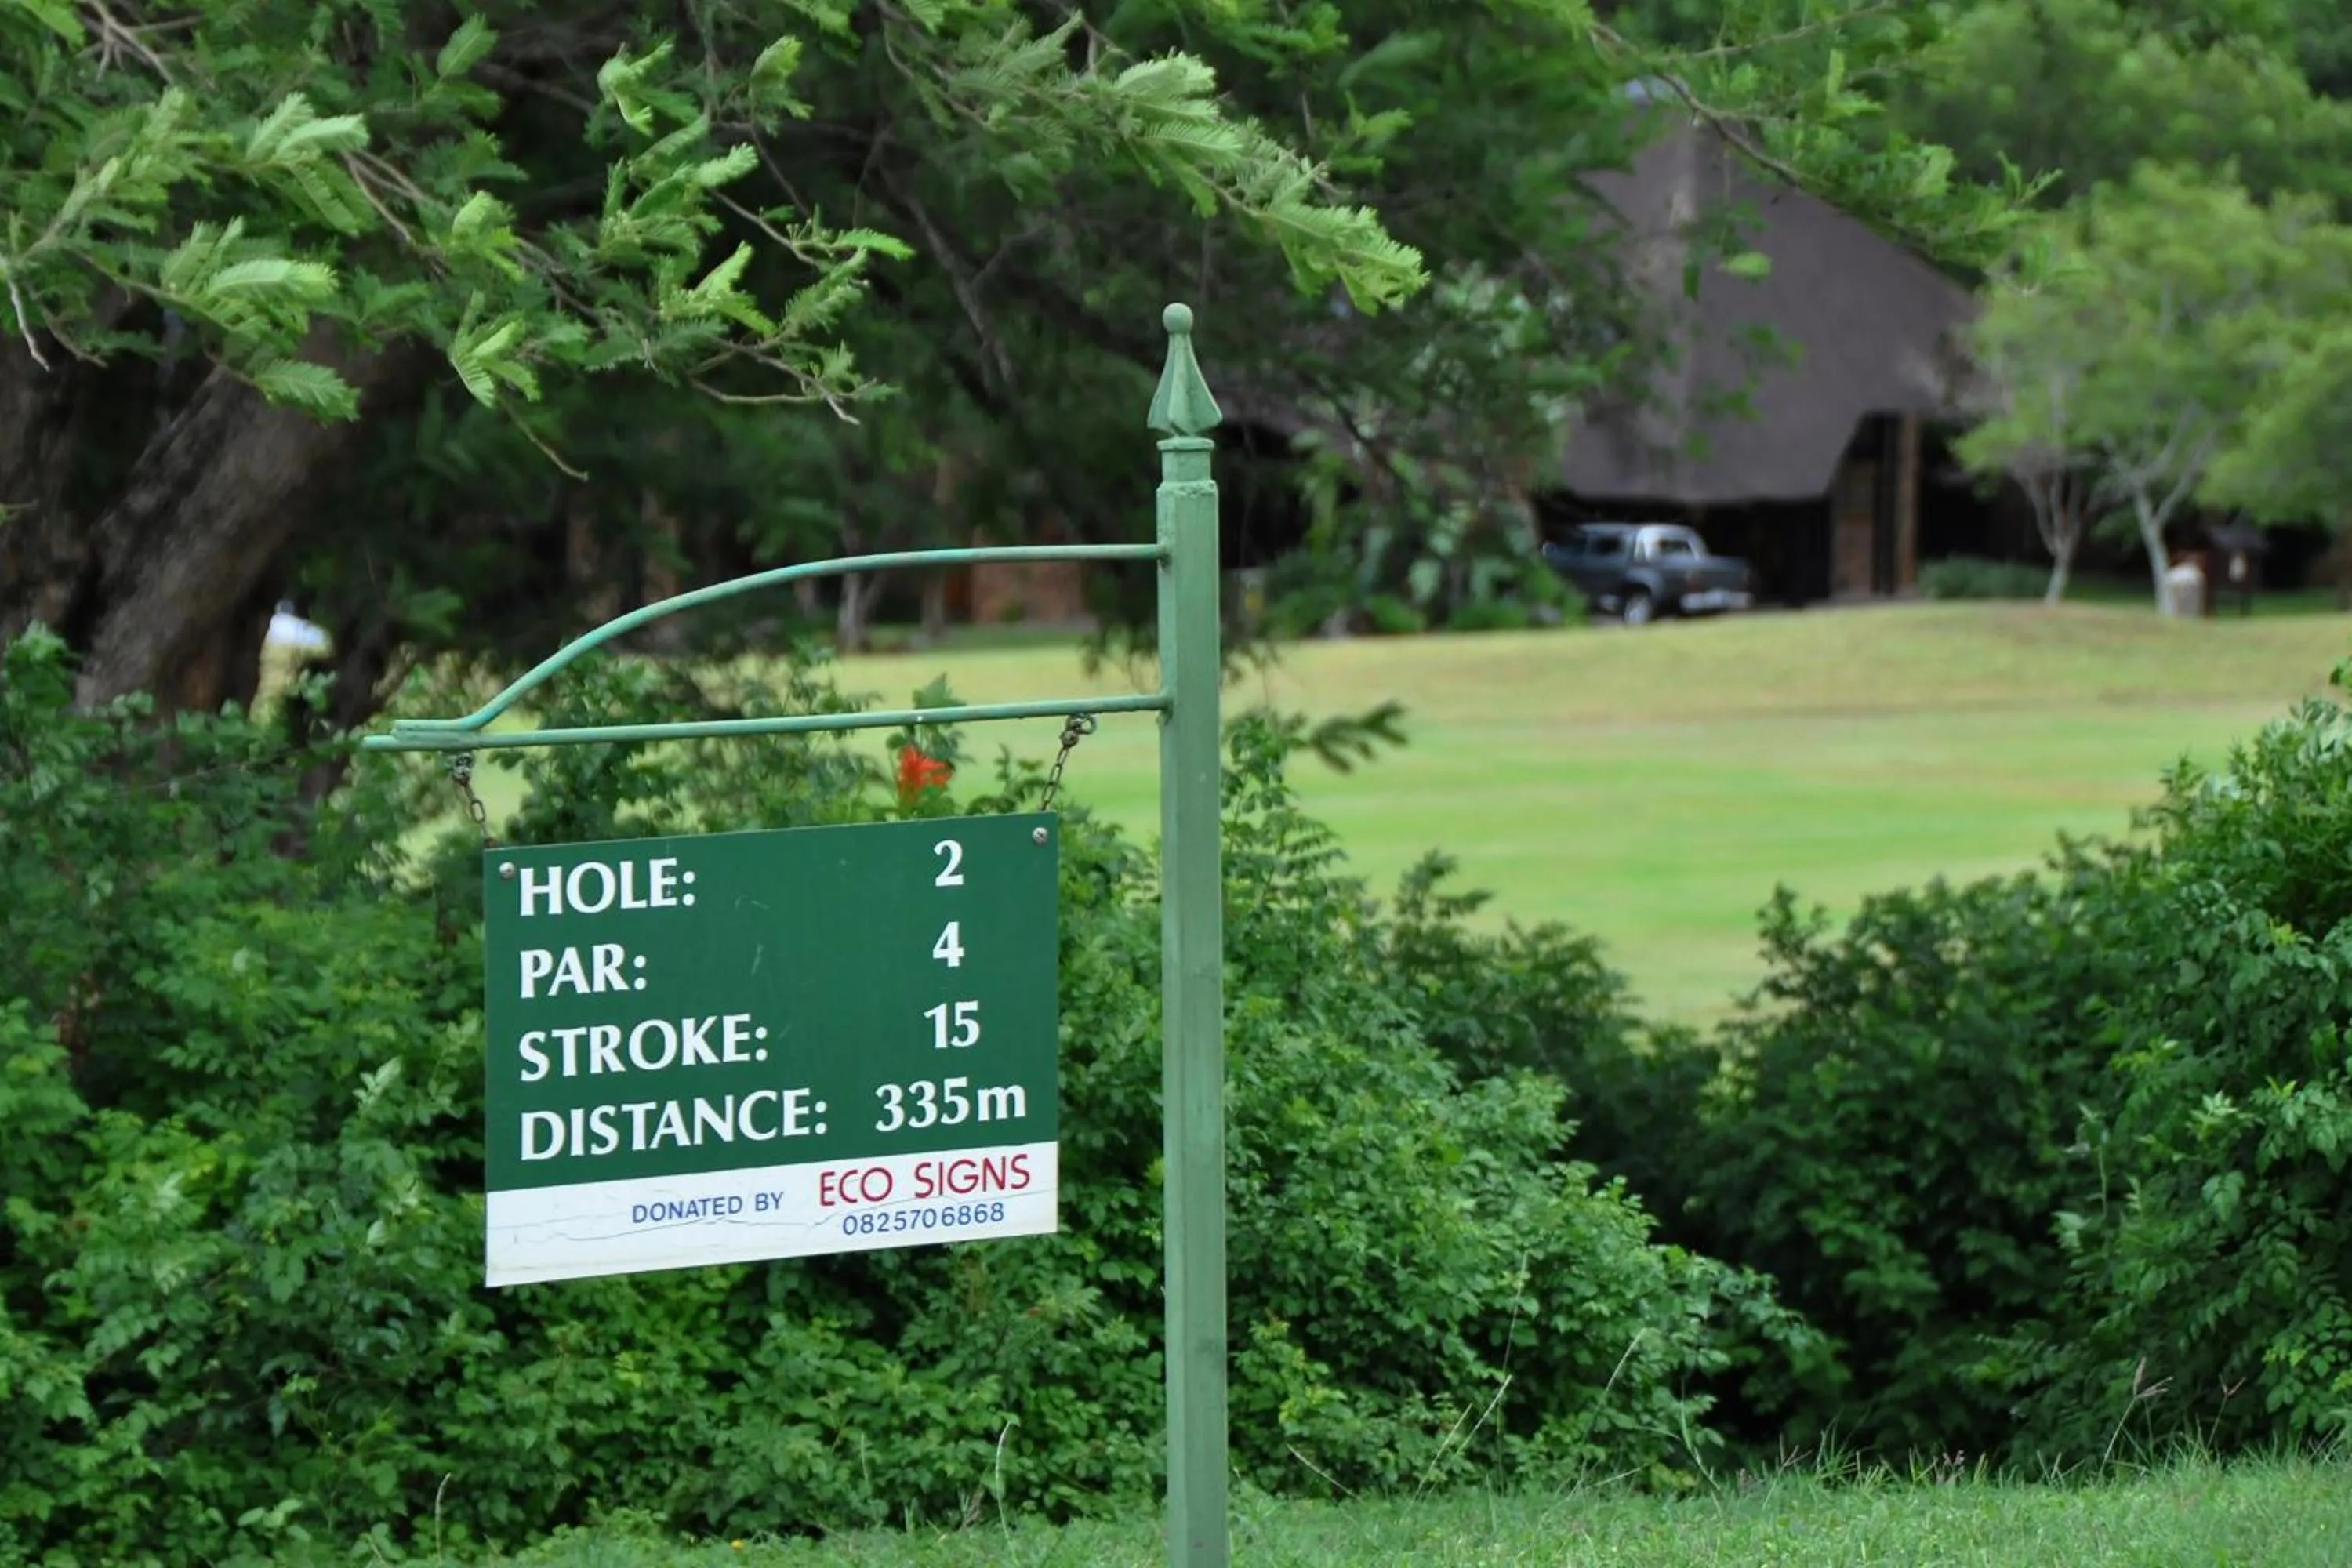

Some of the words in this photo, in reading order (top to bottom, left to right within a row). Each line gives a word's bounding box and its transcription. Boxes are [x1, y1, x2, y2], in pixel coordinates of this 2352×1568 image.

[520, 858, 695, 916] HOLE:
[934, 840, 964, 887] 2
[520, 943, 647, 999] PAR:
[932, 921, 964, 967] 4
[519, 1014, 768, 1081] STROKE:
[924, 1000, 980, 1049] 15
[521, 1087, 828, 1161] DISTANCE:
[876, 1076, 1027, 1131] 335m
[632, 1196, 743, 1224] DONATED
[755, 1191, 784, 1212] BY
[820, 1167, 894, 1206] ECO
[915, 1153, 1030, 1199] SIGNS
[842, 1201, 1004, 1236] 0825706868
